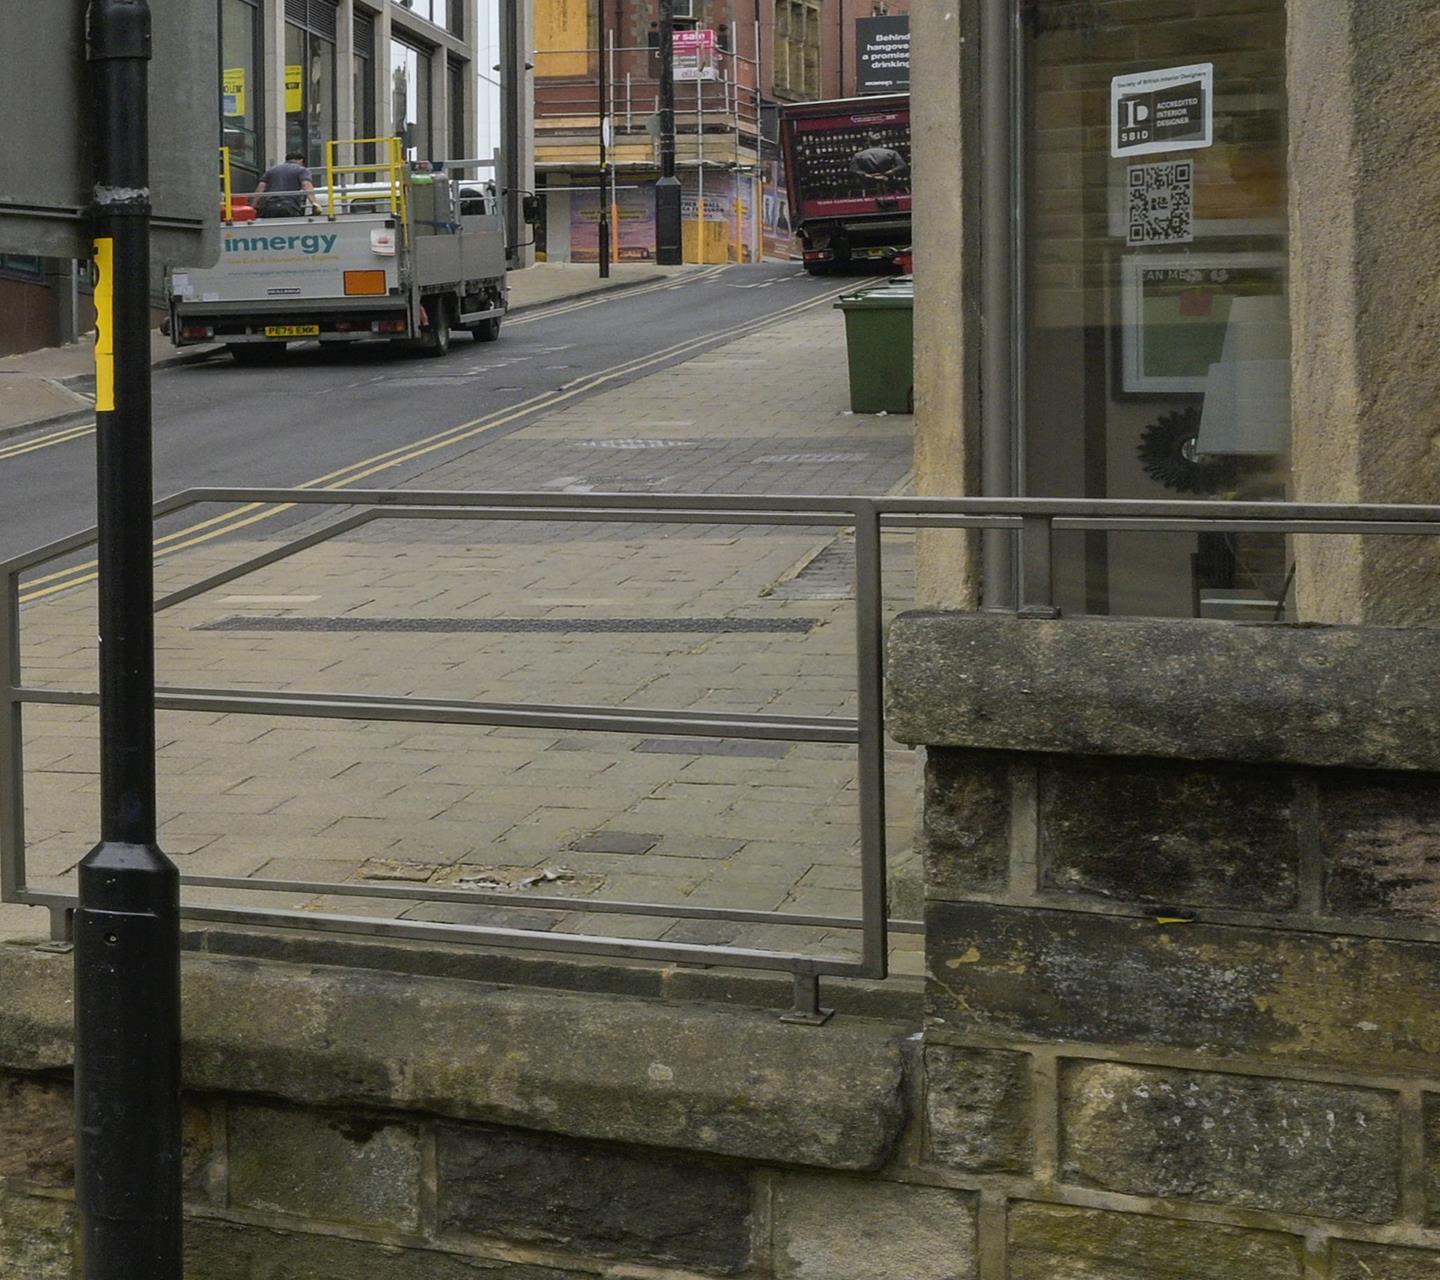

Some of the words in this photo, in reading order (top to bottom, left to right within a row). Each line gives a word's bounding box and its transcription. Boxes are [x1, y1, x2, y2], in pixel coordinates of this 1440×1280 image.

[1156, 98, 1198, 109] ACCREDITED
[1156, 117, 1189, 127] DESIGNER
[1121, 131, 1149, 142] SBID
[224, 232, 338, 254] innergy
